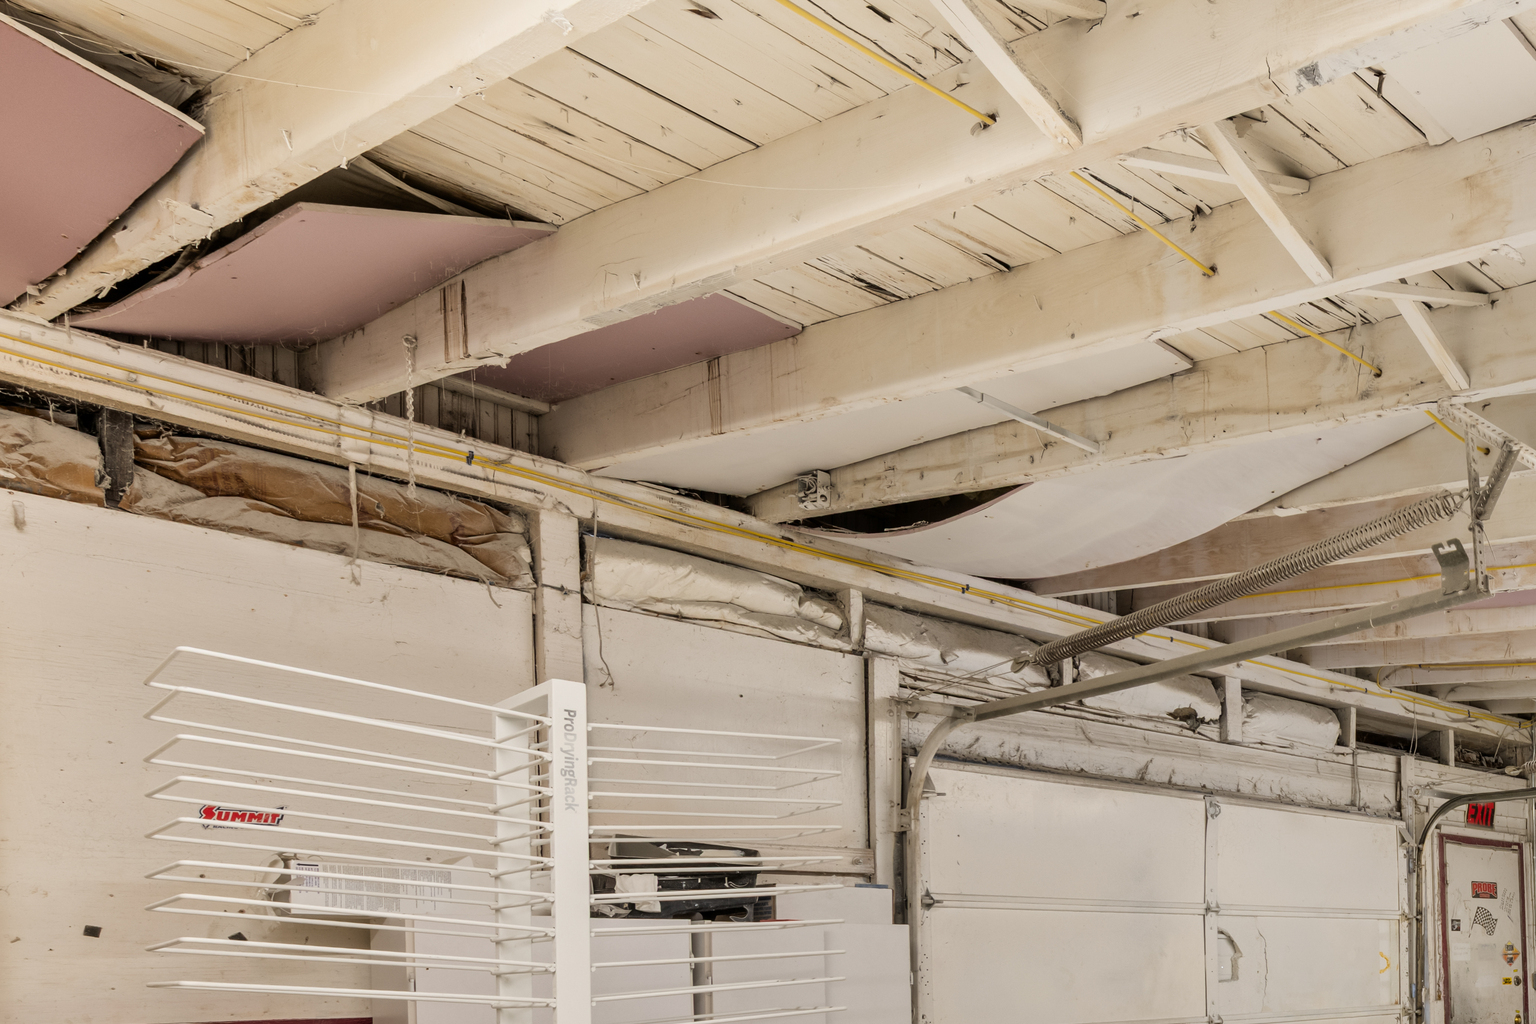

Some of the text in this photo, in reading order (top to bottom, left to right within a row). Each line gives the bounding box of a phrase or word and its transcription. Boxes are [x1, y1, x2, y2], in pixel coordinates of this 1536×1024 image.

[560, 709, 579, 812] ProDryingRack
[200, 804, 282, 825] SUMMIT
[1467, 802, 1495, 827] EXIT
[1472, 882, 1497, 897] PROBE
